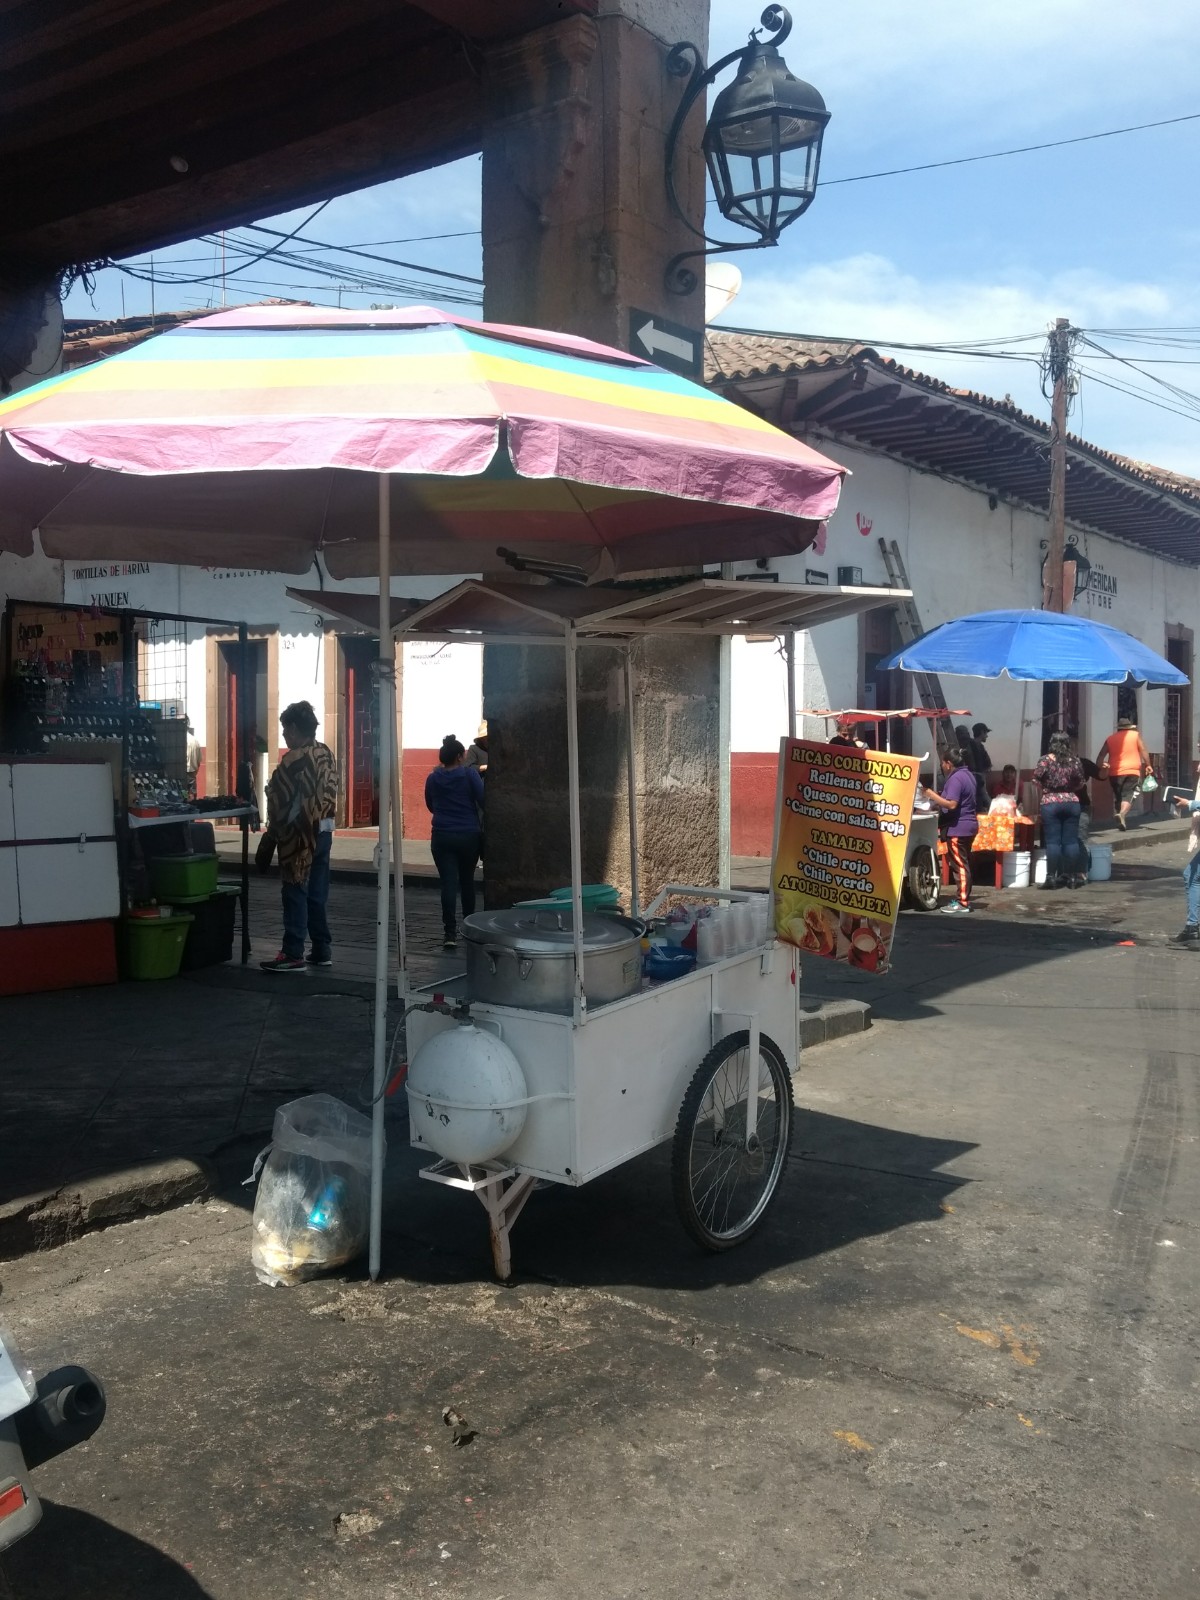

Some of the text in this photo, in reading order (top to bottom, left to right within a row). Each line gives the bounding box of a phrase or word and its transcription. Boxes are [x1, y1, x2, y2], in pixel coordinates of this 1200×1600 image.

[72, 562, 150, 580] TORTILLAS DE HARINA
[1087, 570, 1117, 595] MERICAN
[91, 592, 128, 607] YUNUEN
[1086, 590, 1112, 610] STORE
[792, 748, 912, 780] RICAS CORUNDAS
[810, 769, 883, 794] Rellenas de:
[841, 796, 864, 808] con
[867, 800, 900, 816] rajas
[823, 810, 846, 823] con
[848, 814, 877, 829] salsa
[880, 821, 905, 836] roja
[811, 829, 873, 854] TAMALES
[841, 859, 871, 875] rojo
[834, 875, 874, 893] verde
[779, 875, 891, 916] ATOLE DE CAJETA
